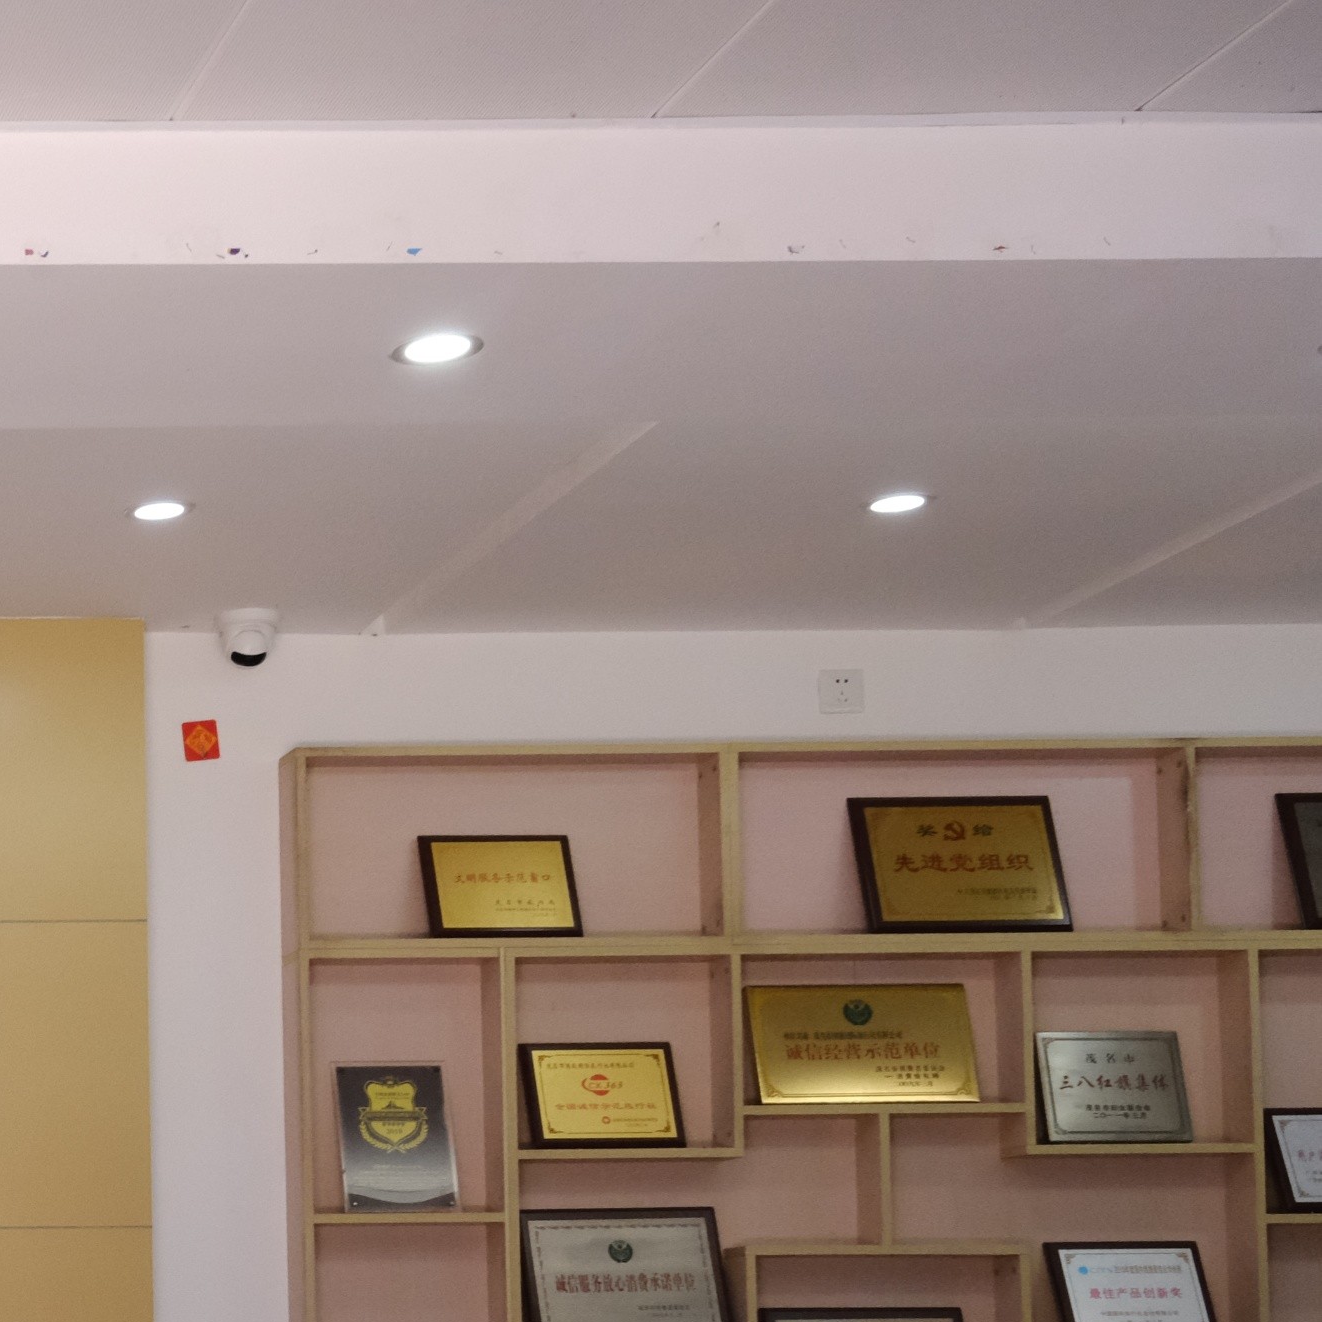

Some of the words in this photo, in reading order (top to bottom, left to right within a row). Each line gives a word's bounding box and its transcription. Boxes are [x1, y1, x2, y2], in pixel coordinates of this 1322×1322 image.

[894, 851, 1035, 873] 先进党组织
[784, 1041, 941, 1062] 诚信经营示范单位
[1059, 1073, 1170, 1093] 三八红旗集体
[1088, 1286, 1183, 1300] 最佳产品创新奖
